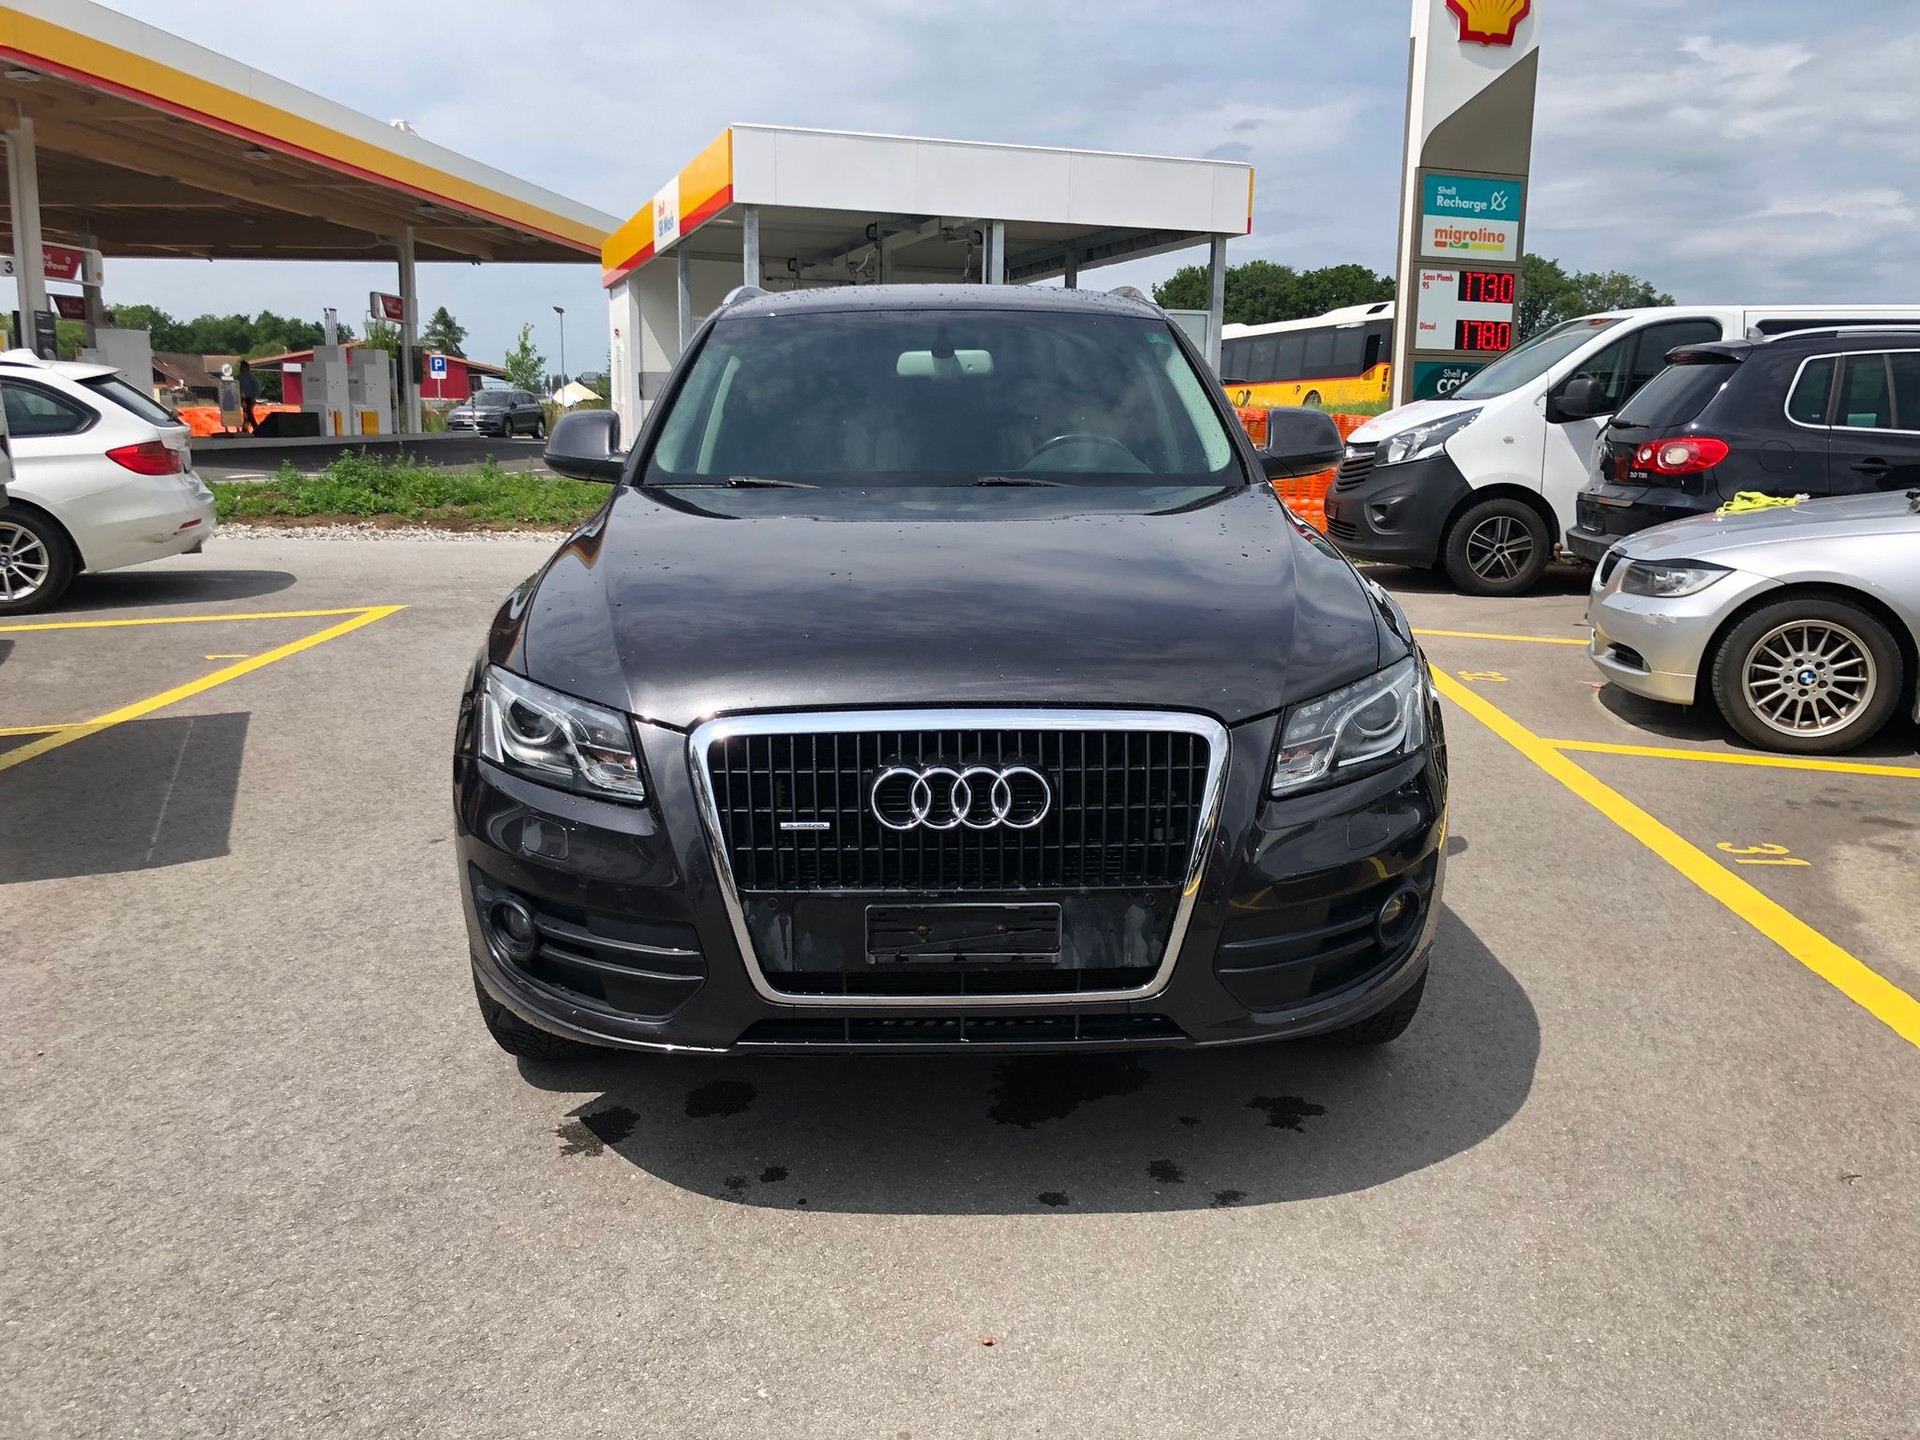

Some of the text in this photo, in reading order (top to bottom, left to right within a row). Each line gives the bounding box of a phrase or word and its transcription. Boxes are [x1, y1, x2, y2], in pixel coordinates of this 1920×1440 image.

[1437, 186, 1457, 196] Shell
[1436, 195, 1488, 212] Recharge
[1434, 225, 1506, 244] migrolino
[4, 260, 14, 274] 3
[1422, 272, 1454, 282] Sans Plomb
[1421, 281, 1430, 290] 95
[1419, 321, 1437, 330] Diesel
[434, 359, 443, 371] P
[1443, 368, 1462, 378] Shell
[1436, 371, 1469, 394] caf
